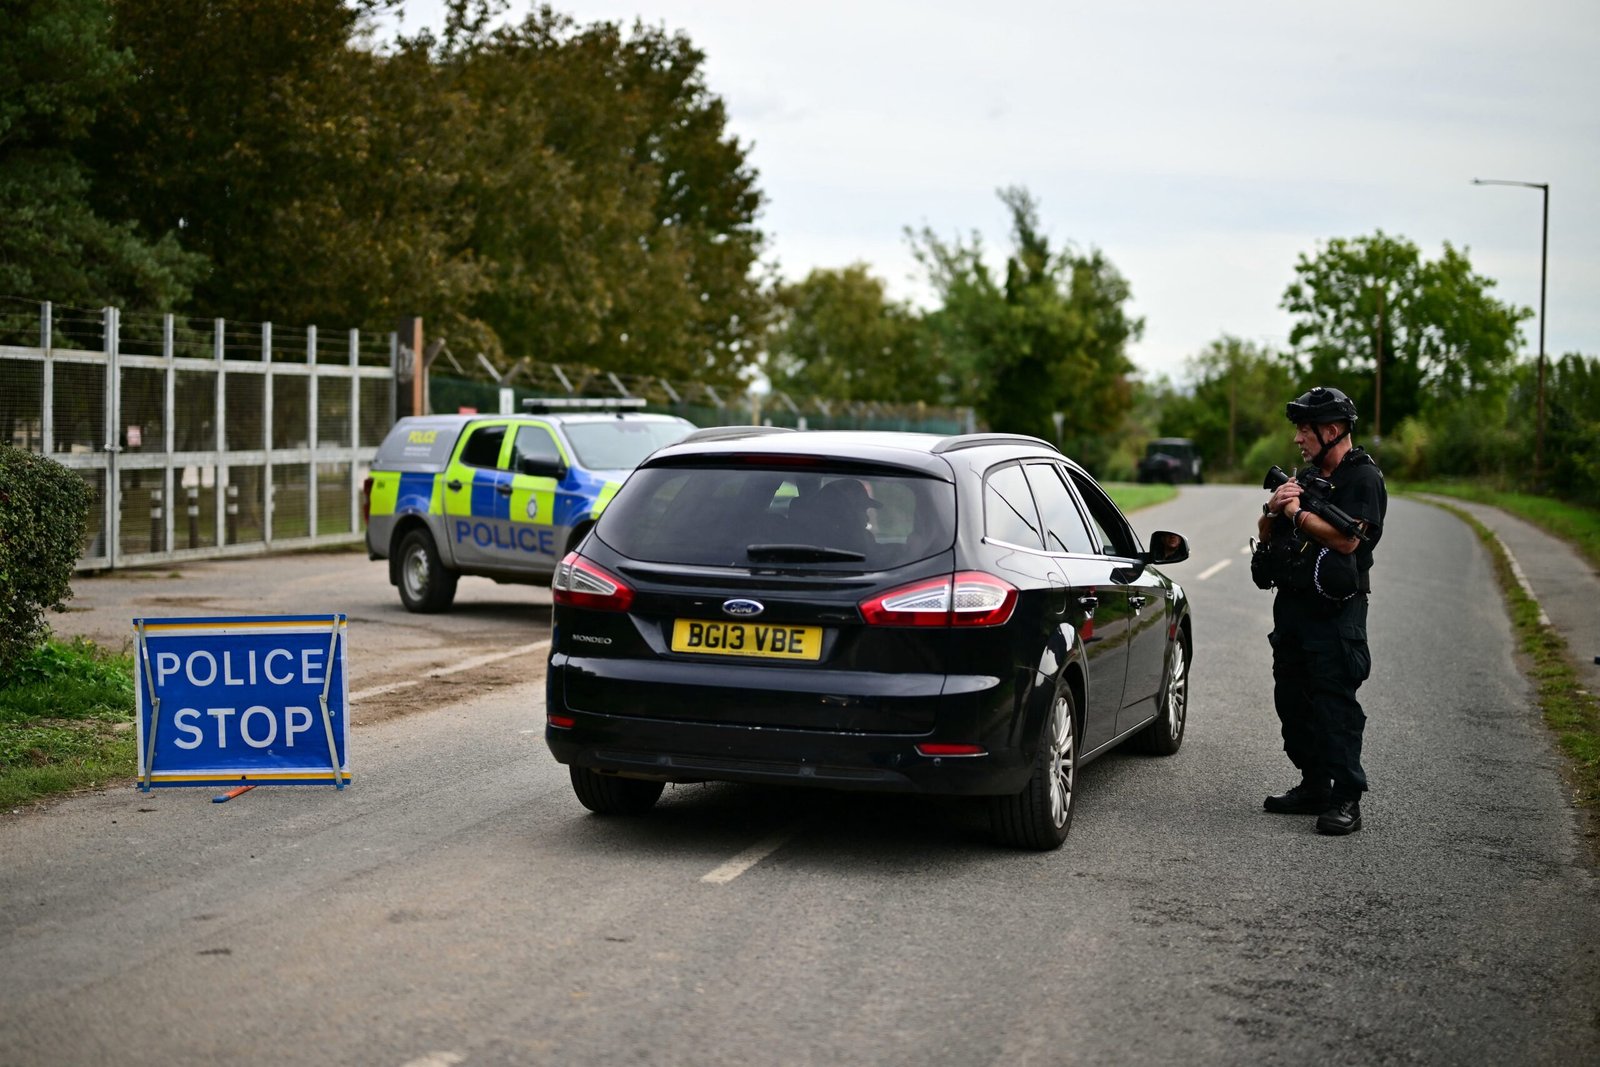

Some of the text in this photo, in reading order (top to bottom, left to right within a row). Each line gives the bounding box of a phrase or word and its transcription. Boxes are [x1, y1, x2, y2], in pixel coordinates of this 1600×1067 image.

[455, 520, 556, 556] POLICE
[729, 603, 753, 614] Ford
[572, 633, 613, 645] MONDEO
[687, 623, 805, 654] BG13 VBE
[156, 648, 325, 687] POLICE
[173, 705, 313, 750] STOP
